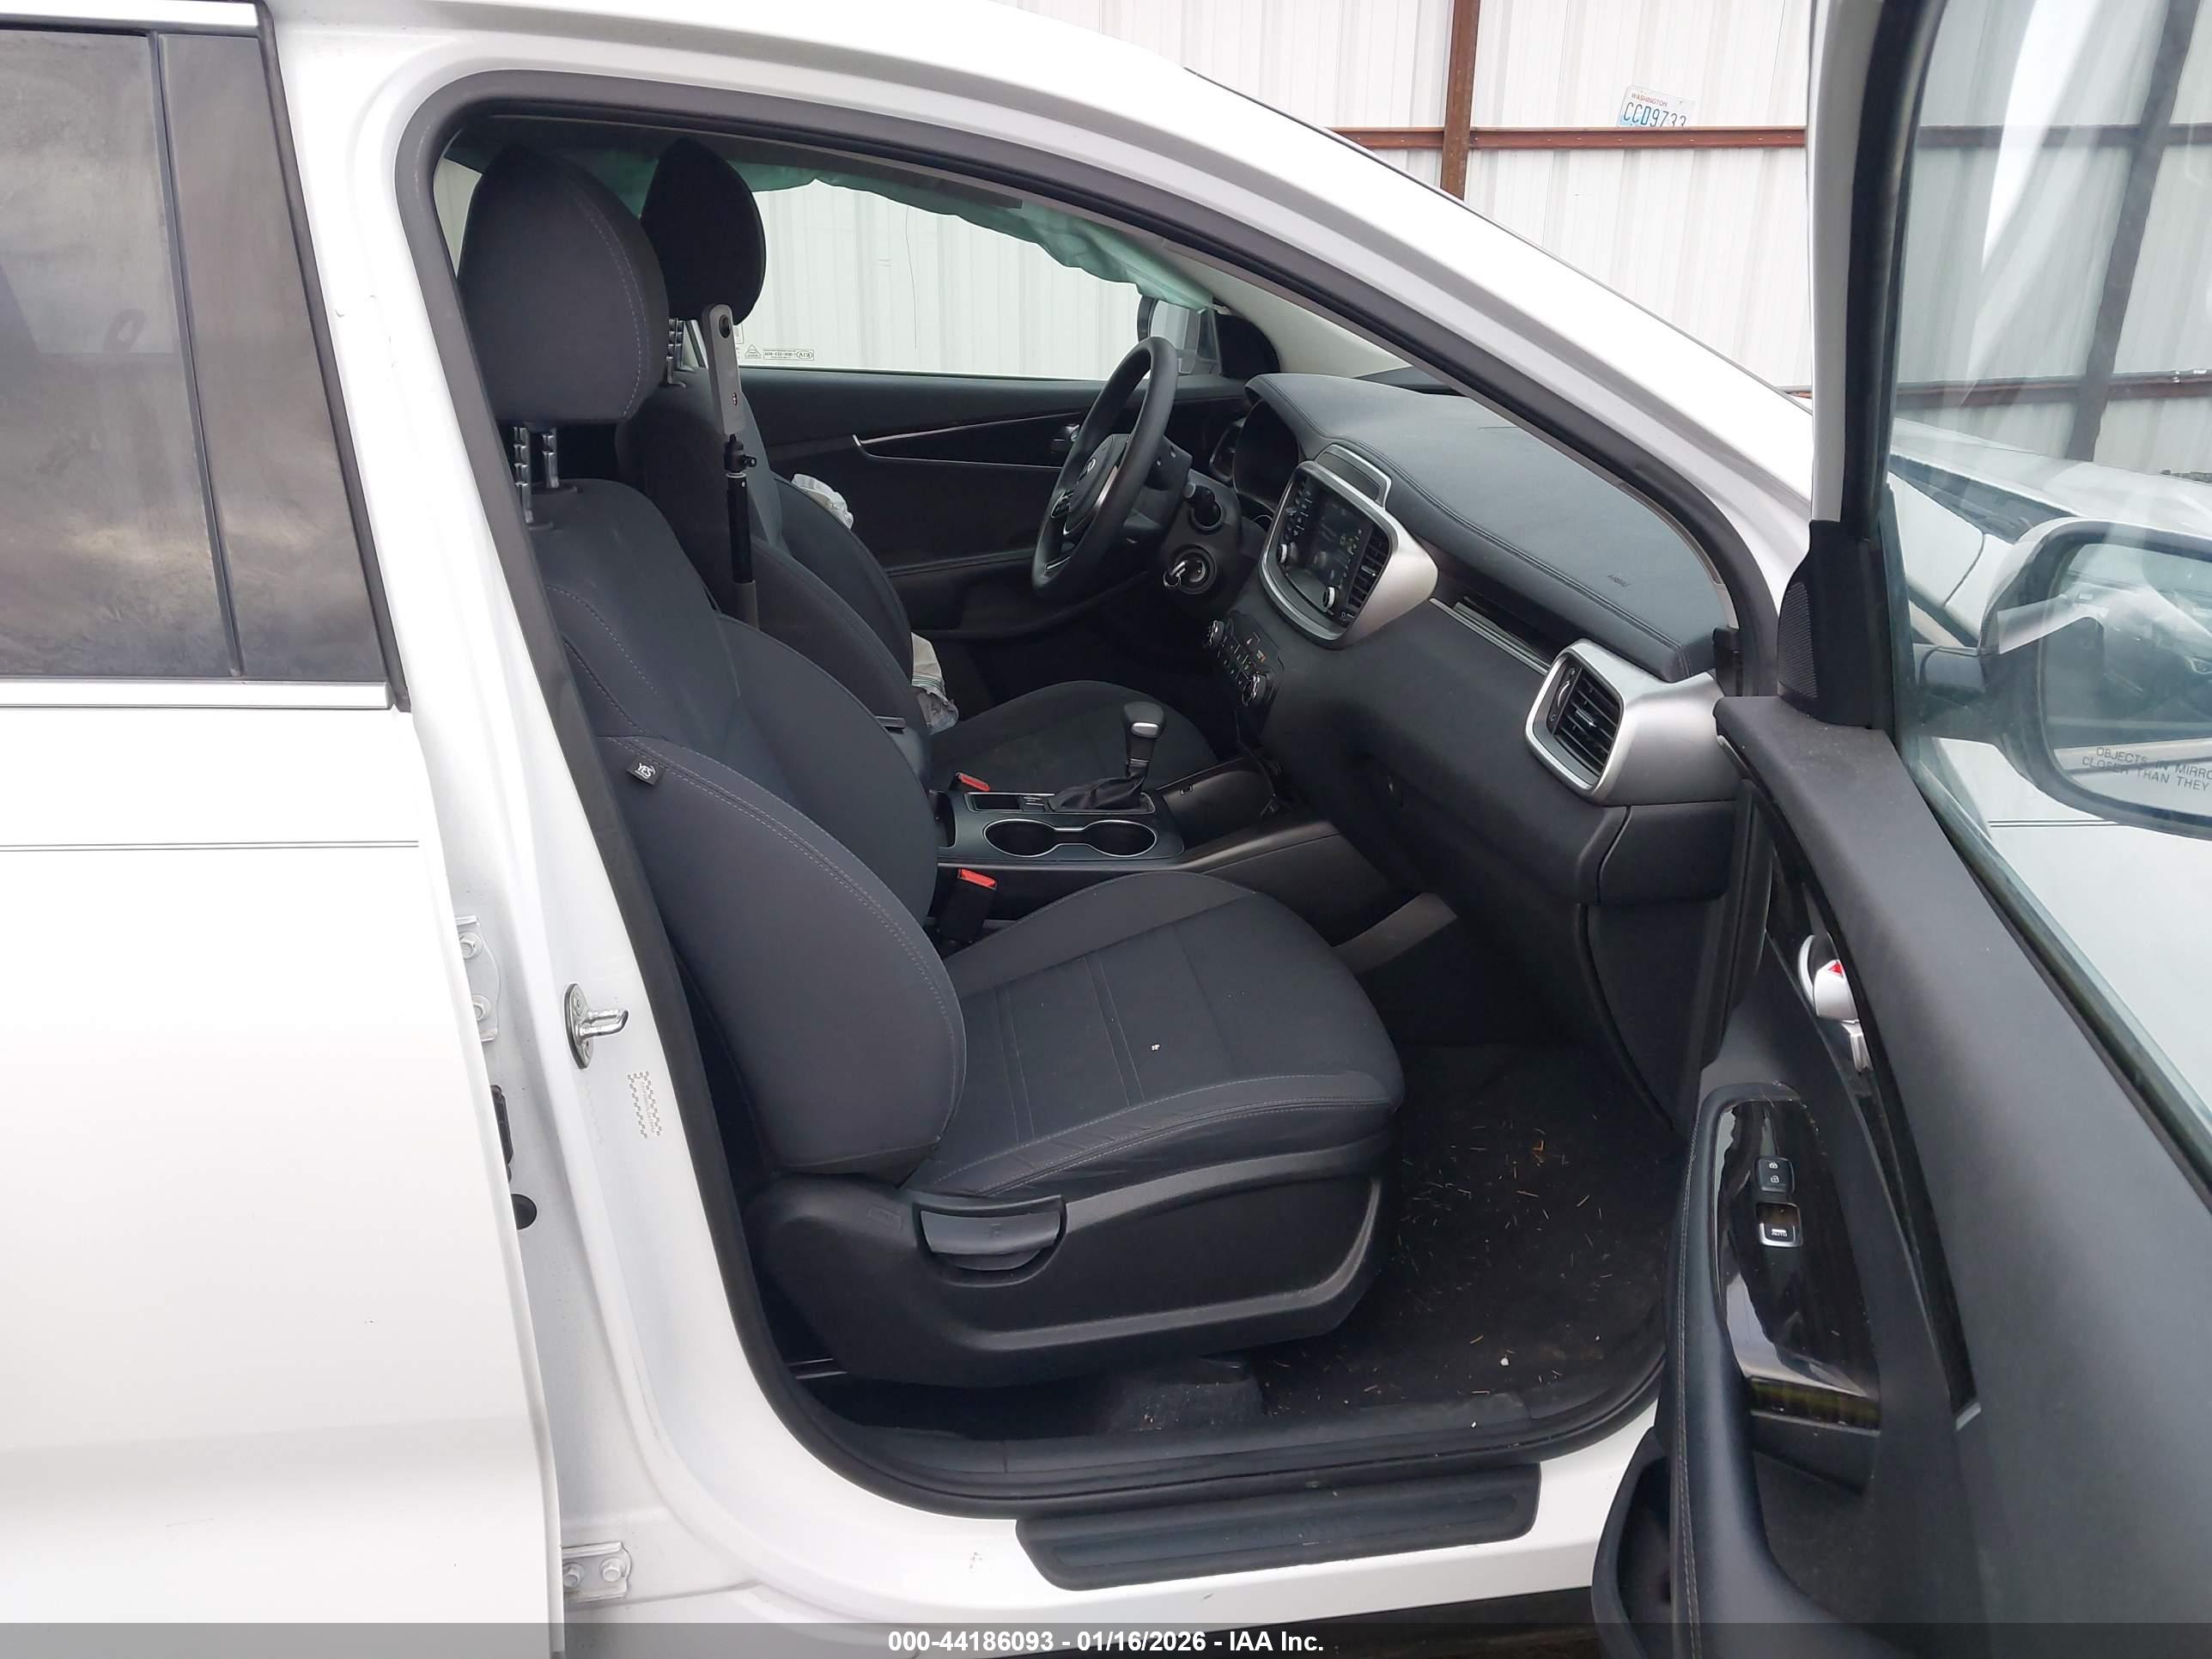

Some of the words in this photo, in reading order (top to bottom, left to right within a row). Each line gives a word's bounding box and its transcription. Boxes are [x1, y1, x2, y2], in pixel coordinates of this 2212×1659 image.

[1632, 92, 1668, 107] WASHINGTON
[2096, 747, 2148, 764] OBJECTS
[637, 763, 653, 777] YES
[2082, 756, 2129, 775] CLOSER
[2136, 768, 2170, 784] THAN
[2177, 775, 2209, 791] THEY
